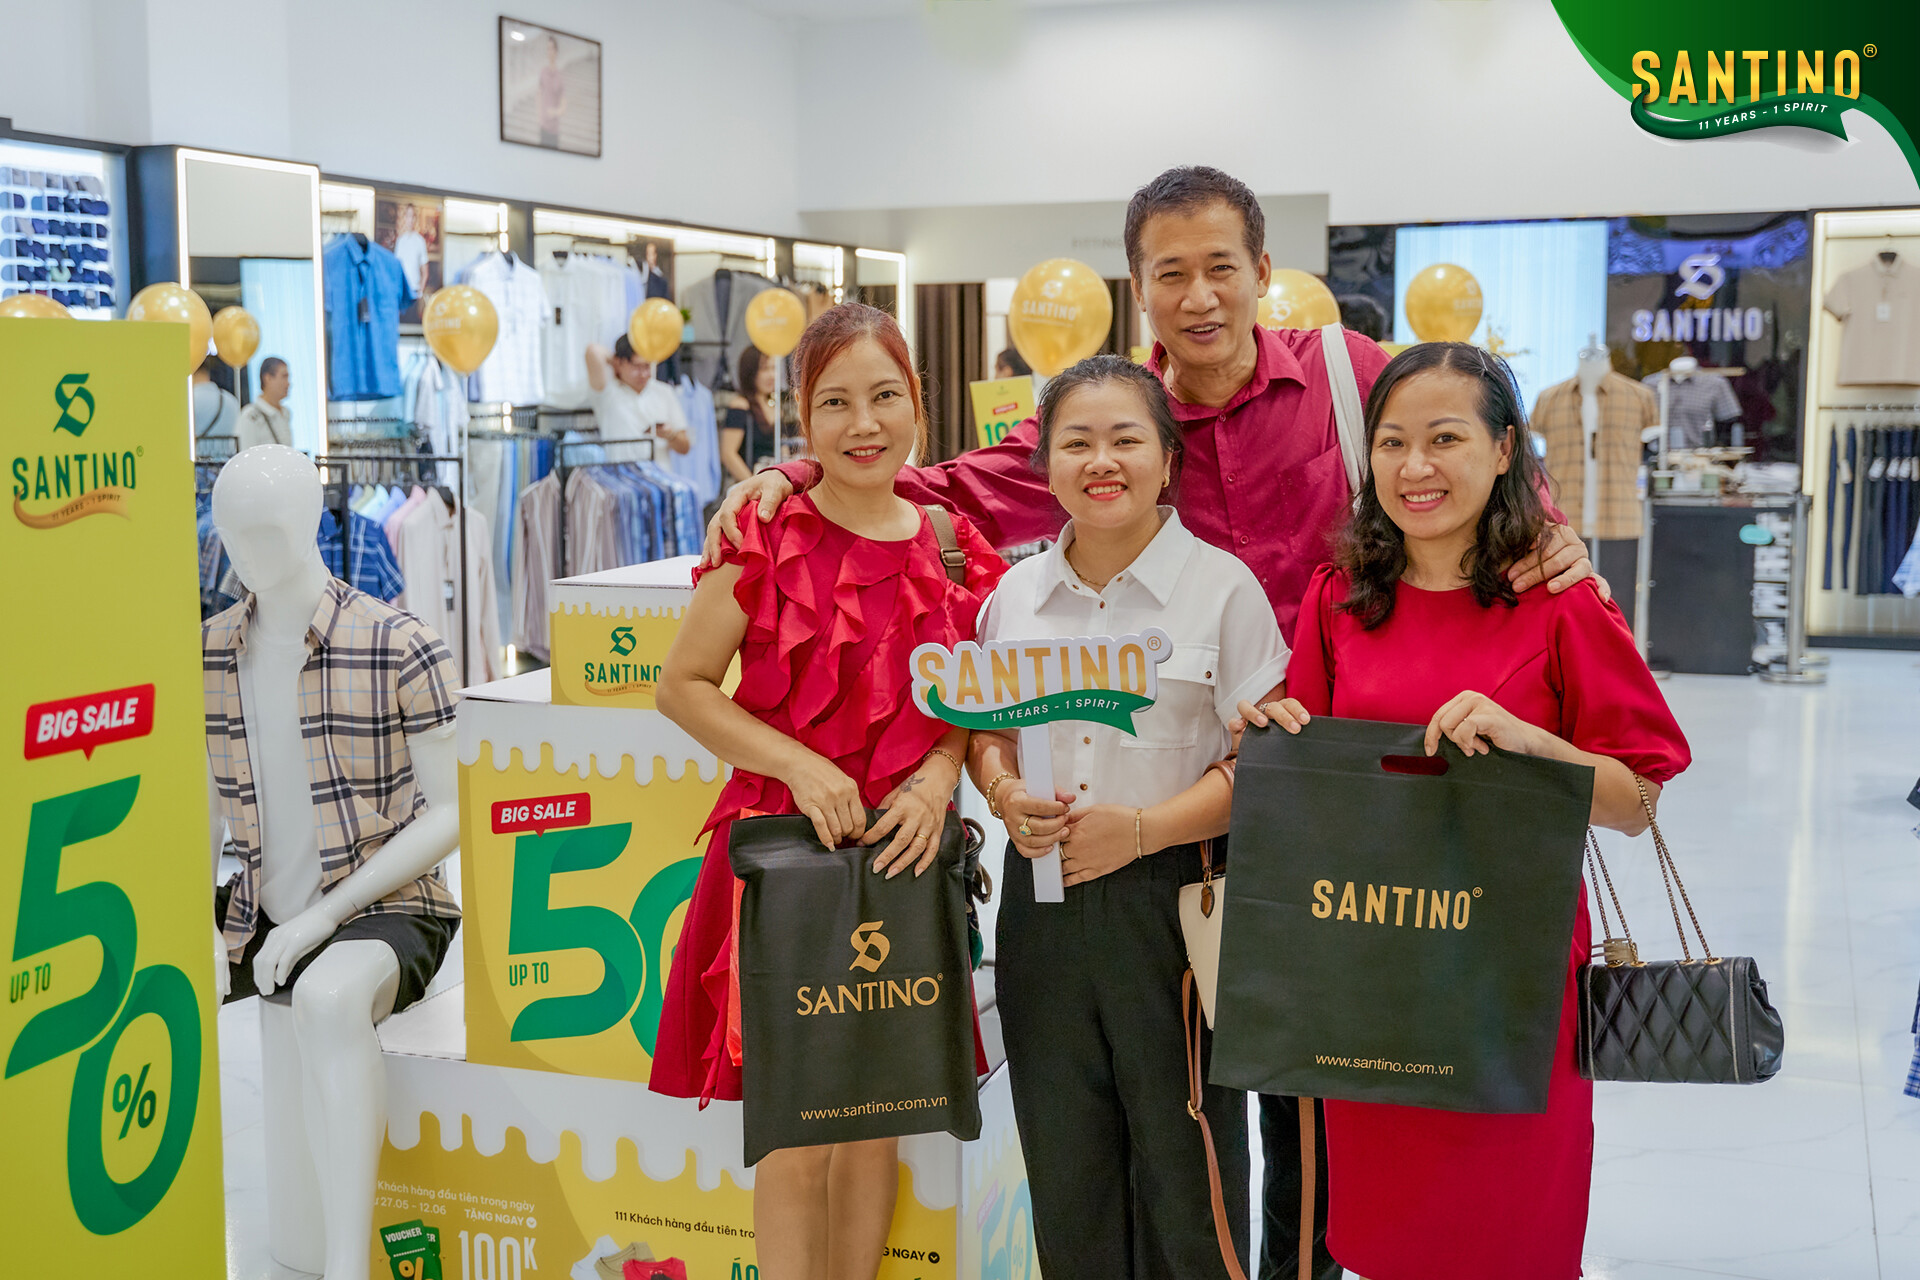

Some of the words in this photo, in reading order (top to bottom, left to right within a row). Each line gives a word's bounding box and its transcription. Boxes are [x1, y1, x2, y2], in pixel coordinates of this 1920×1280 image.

[1021, 299, 1077, 321] SANTINO
[61, 502, 85, 516] YEARS
[98, 493, 121, 503] SPIRIT
[36, 708, 78, 743] BIG
[81, 697, 139, 734] SALE
[991, 713, 1004, 722] 11
[1008, 704, 1049, 720] YEARS
[1065, 700, 1070, 709] 1
[1075, 699, 1120, 711] SPIRIT
[500, 805, 530, 824] BIG
[532, 800, 577, 820] SALE
[1311, 879, 1471, 931] SANTINO
[10, 971, 30, 1004] UP
[35, 962, 51, 995] TO
[509, 964, 528, 987] UP
[532, 962, 549, 985] TO
[796, 976, 940, 1016] SANTINO
[1315, 1054, 1454, 1076] www.santino.com.vn
[800, 1095, 948, 1120] www.santino.com.vn
[377, 1180, 409, 1193] Khách
[411, 1185, 436, 1200] hàng
[437, 1187, 457, 1200] đầu
[459, 1192, 479, 1204] tiên
[480, 1196, 508, 1210] trong
[509, 1199, 535, 1213] ngày
[380, 1196, 409, 1210] 27.05
[420, 1202, 447, 1215] 12.06
[464, 1208, 493, 1222] TẶNG
[495, 1214, 524, 1226] NGAY
[615, 1211, 627, 1221] 111
[629, 1213, 663, 1226] Khách
[665, 1217, 691, 1232] hàng
[694, 1220, 714, 1233] đầu
[717, 1224, 737, 1236] tiên
[740, 1229, 755, 1239] tro
[385, 1226, 422, 1243] VOUCHER
[892, 1247, 925, 1261] NGAY
